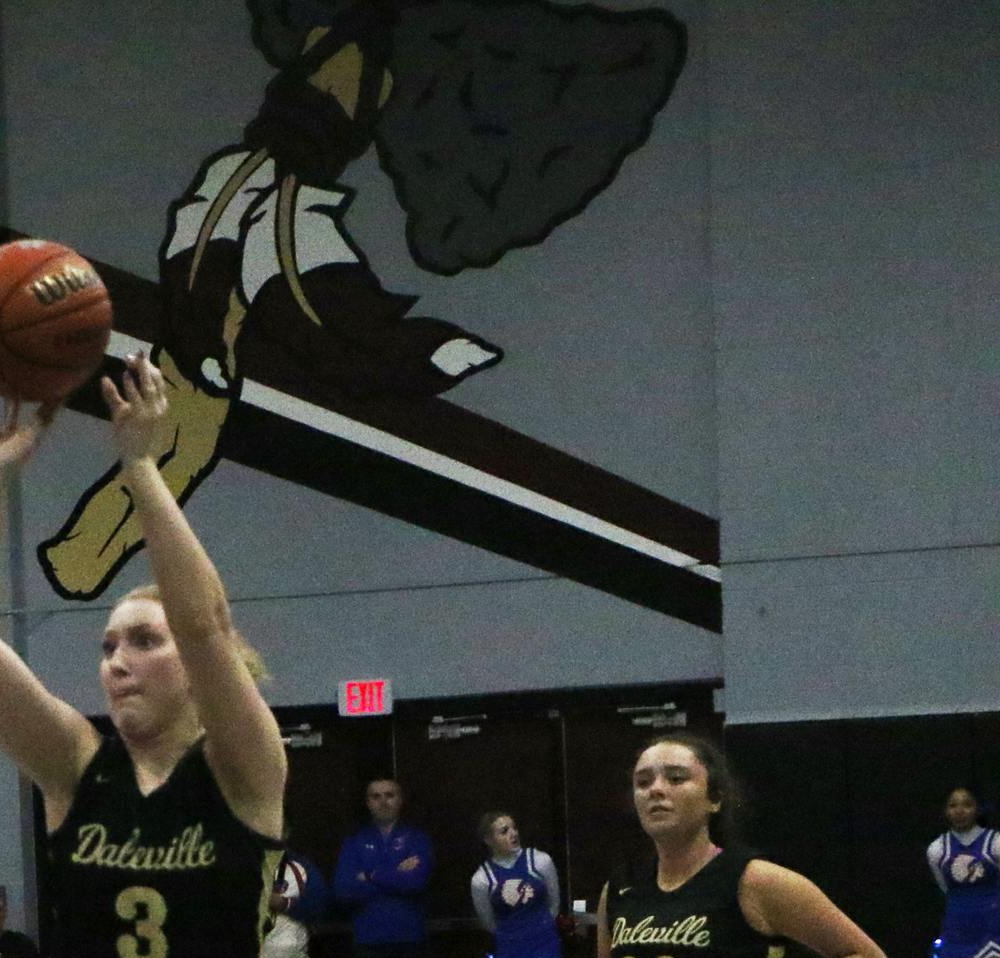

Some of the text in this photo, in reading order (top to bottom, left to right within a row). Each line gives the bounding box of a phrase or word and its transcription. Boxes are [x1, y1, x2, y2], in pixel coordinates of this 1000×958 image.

[345, 681, 385, 714] EXIT
[71, 823, 217, 870] Daleville
[611, 915, 711, 949] Daleville
